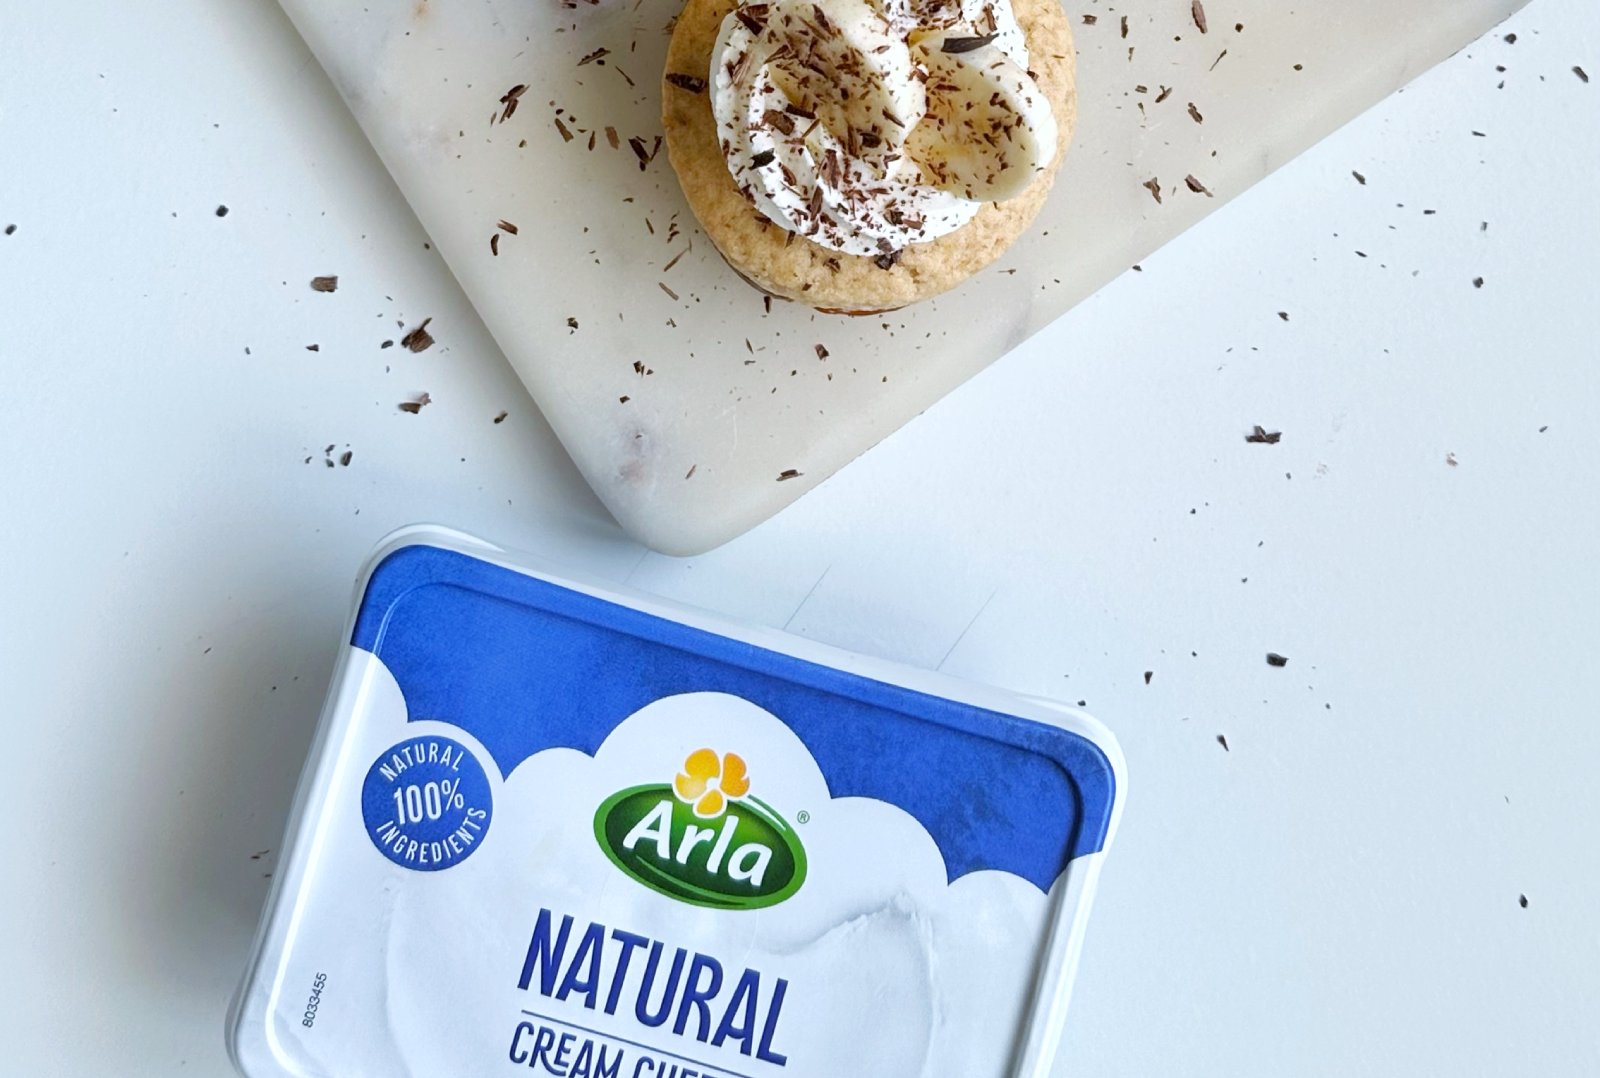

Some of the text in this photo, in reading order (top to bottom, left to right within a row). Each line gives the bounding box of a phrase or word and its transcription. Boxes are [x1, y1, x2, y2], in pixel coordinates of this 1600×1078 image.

[379, 742, 464, 782] NATURAL
[393, 777, 464, 825] 100%
[376, 807, 487, 863] INGREDIENTS
[622, 800, 773, 887] Arla
[302, 972, 327, 1028] 8033455
[517, 907, 789, 1067] NATURAL
[509, 1021, 624, 1078] CREAM
